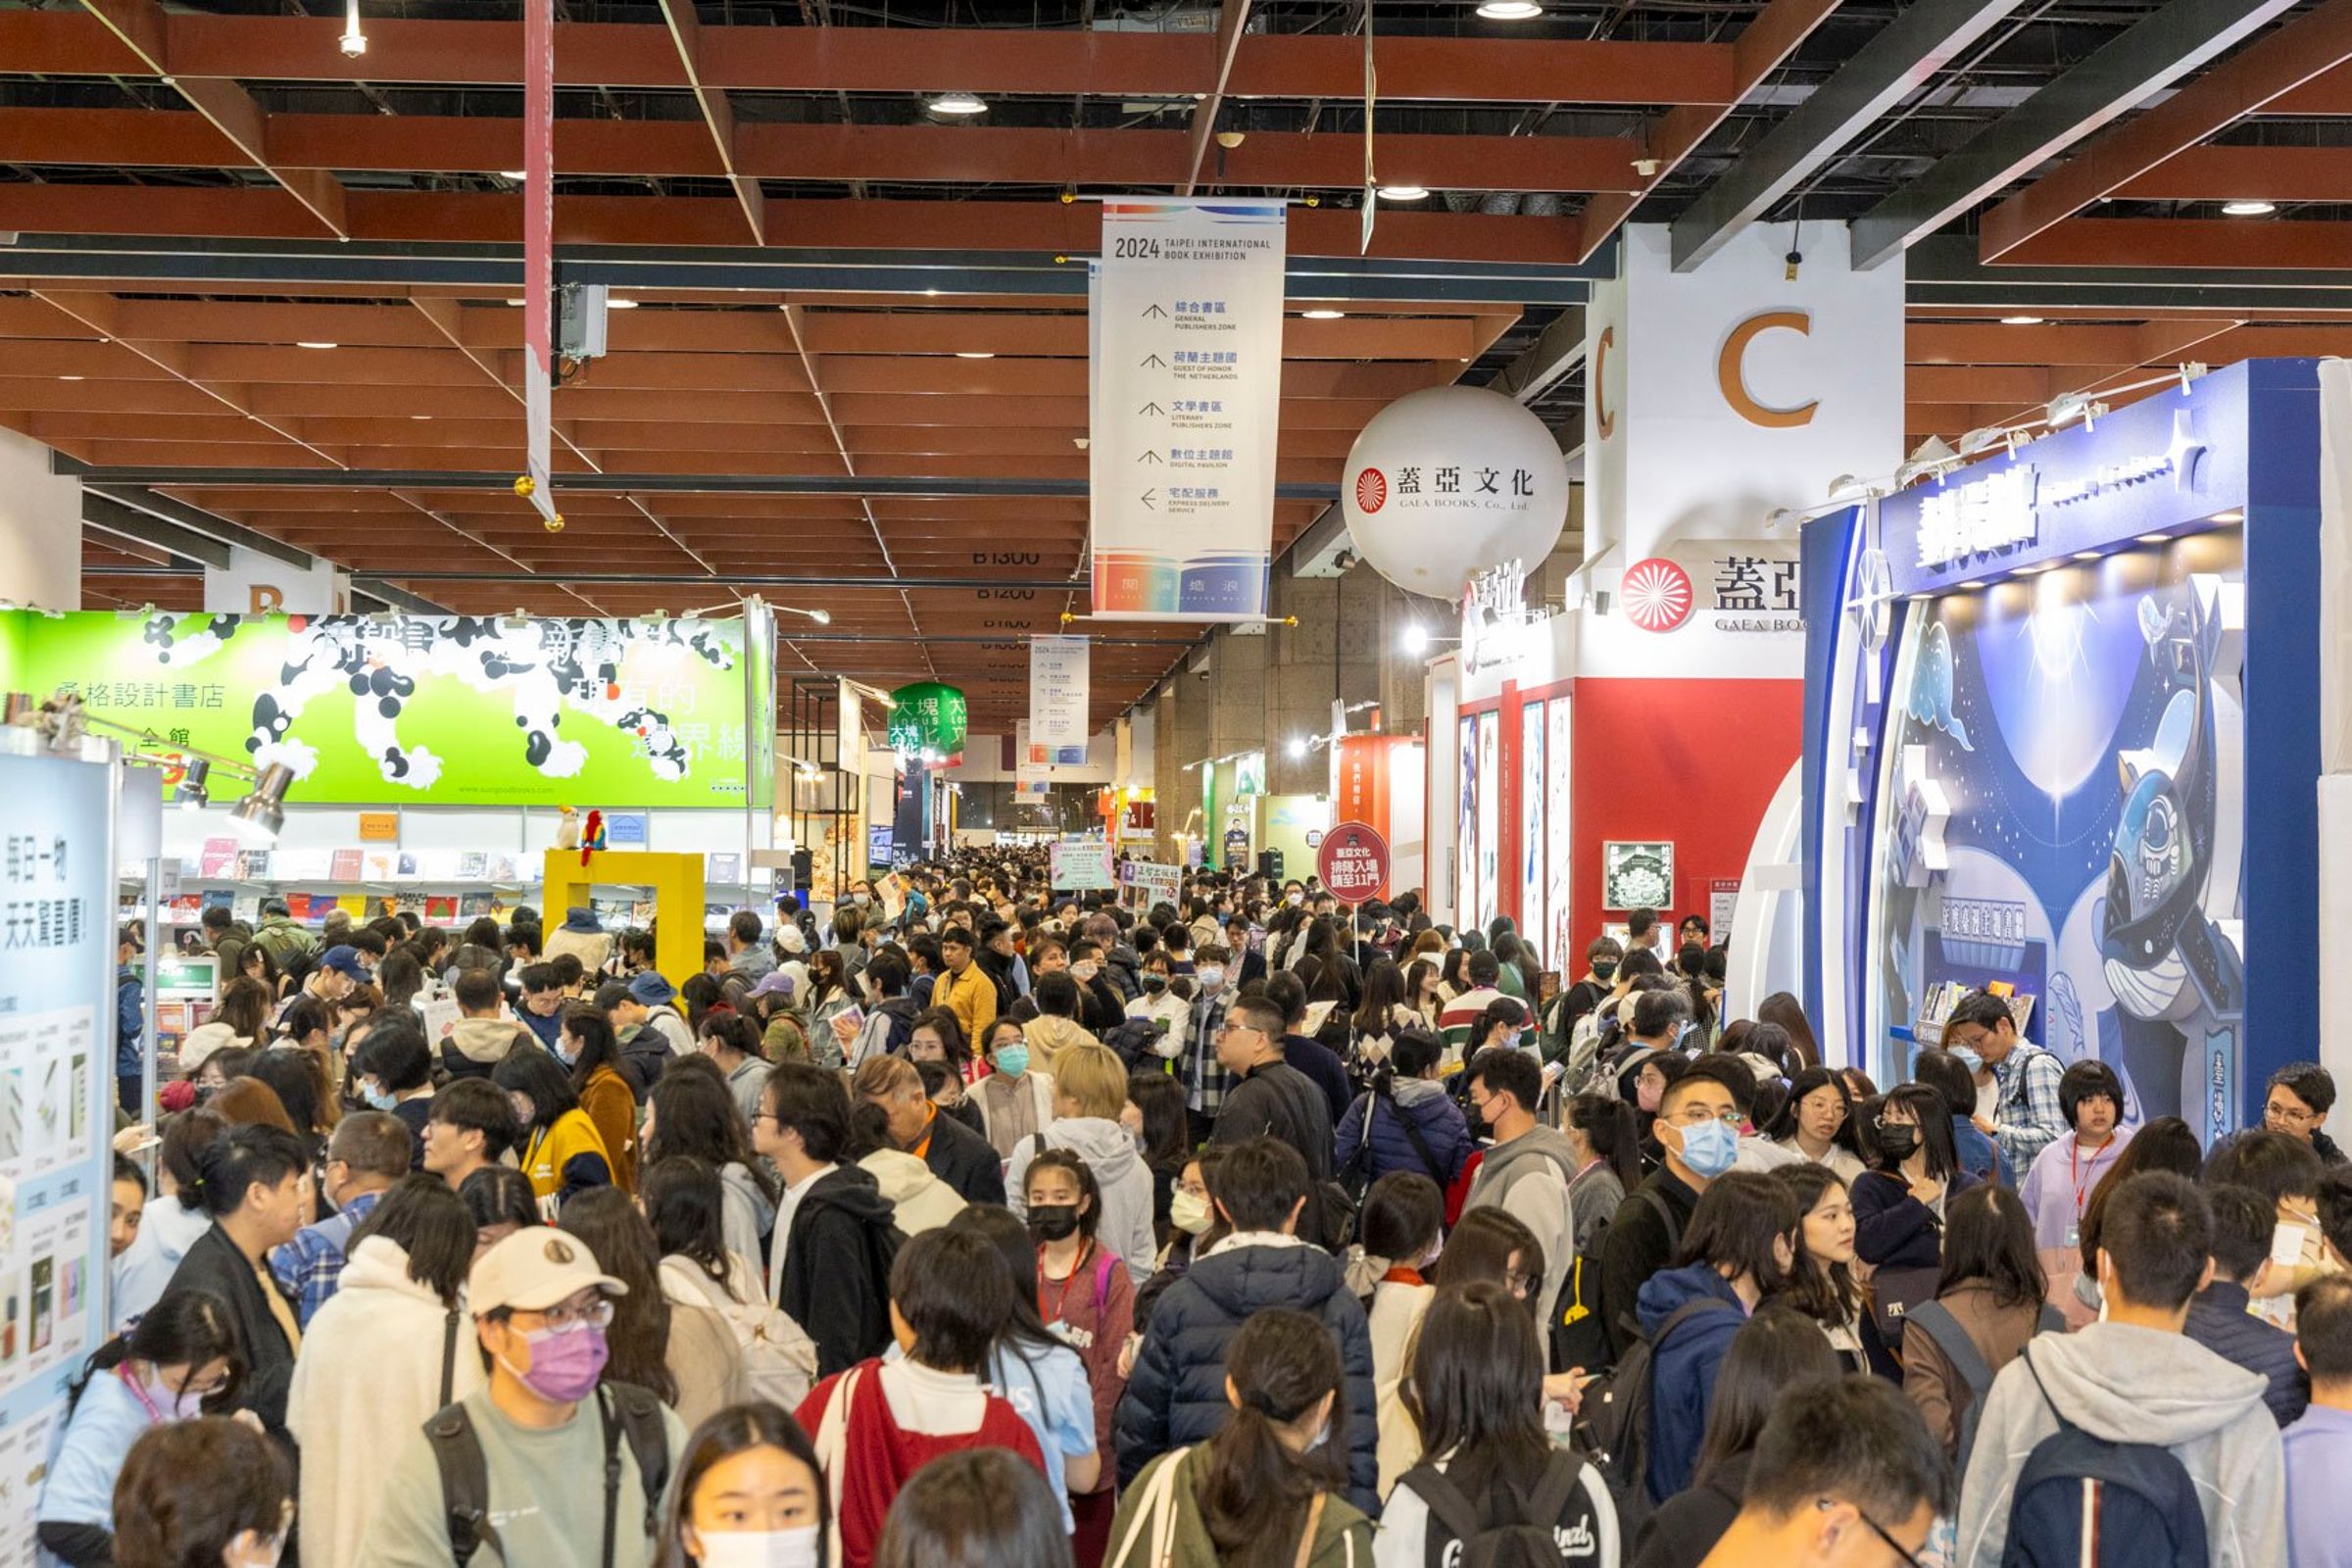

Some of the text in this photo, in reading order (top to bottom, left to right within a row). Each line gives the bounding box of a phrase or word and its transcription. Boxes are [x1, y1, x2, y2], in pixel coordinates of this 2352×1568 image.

[1115, 237, 1160, 259] 2024
[1164, 238, 1271, 249] TAIPEI INTERNATIONAL
[1164, 251, 1247, 261] BOOK EXHIBITION
[1175, 302, 1226, 314] 綜合書區
[1174, 351, 1238, 364] 荷蘭主題國
[1718, 311, 1821, 428] C
[1172, 400, 1223, 413] 文學書區
[1170, 449, 1234, 461] 數位主題館
[1396, 466, 1535, 497] 蓋亞文化
[1169, 487, 1219, 499] 宅配服務
[1715, 618, 1762, 632] GAEA
[1331, 858, 1379, 875] 排隊入場
